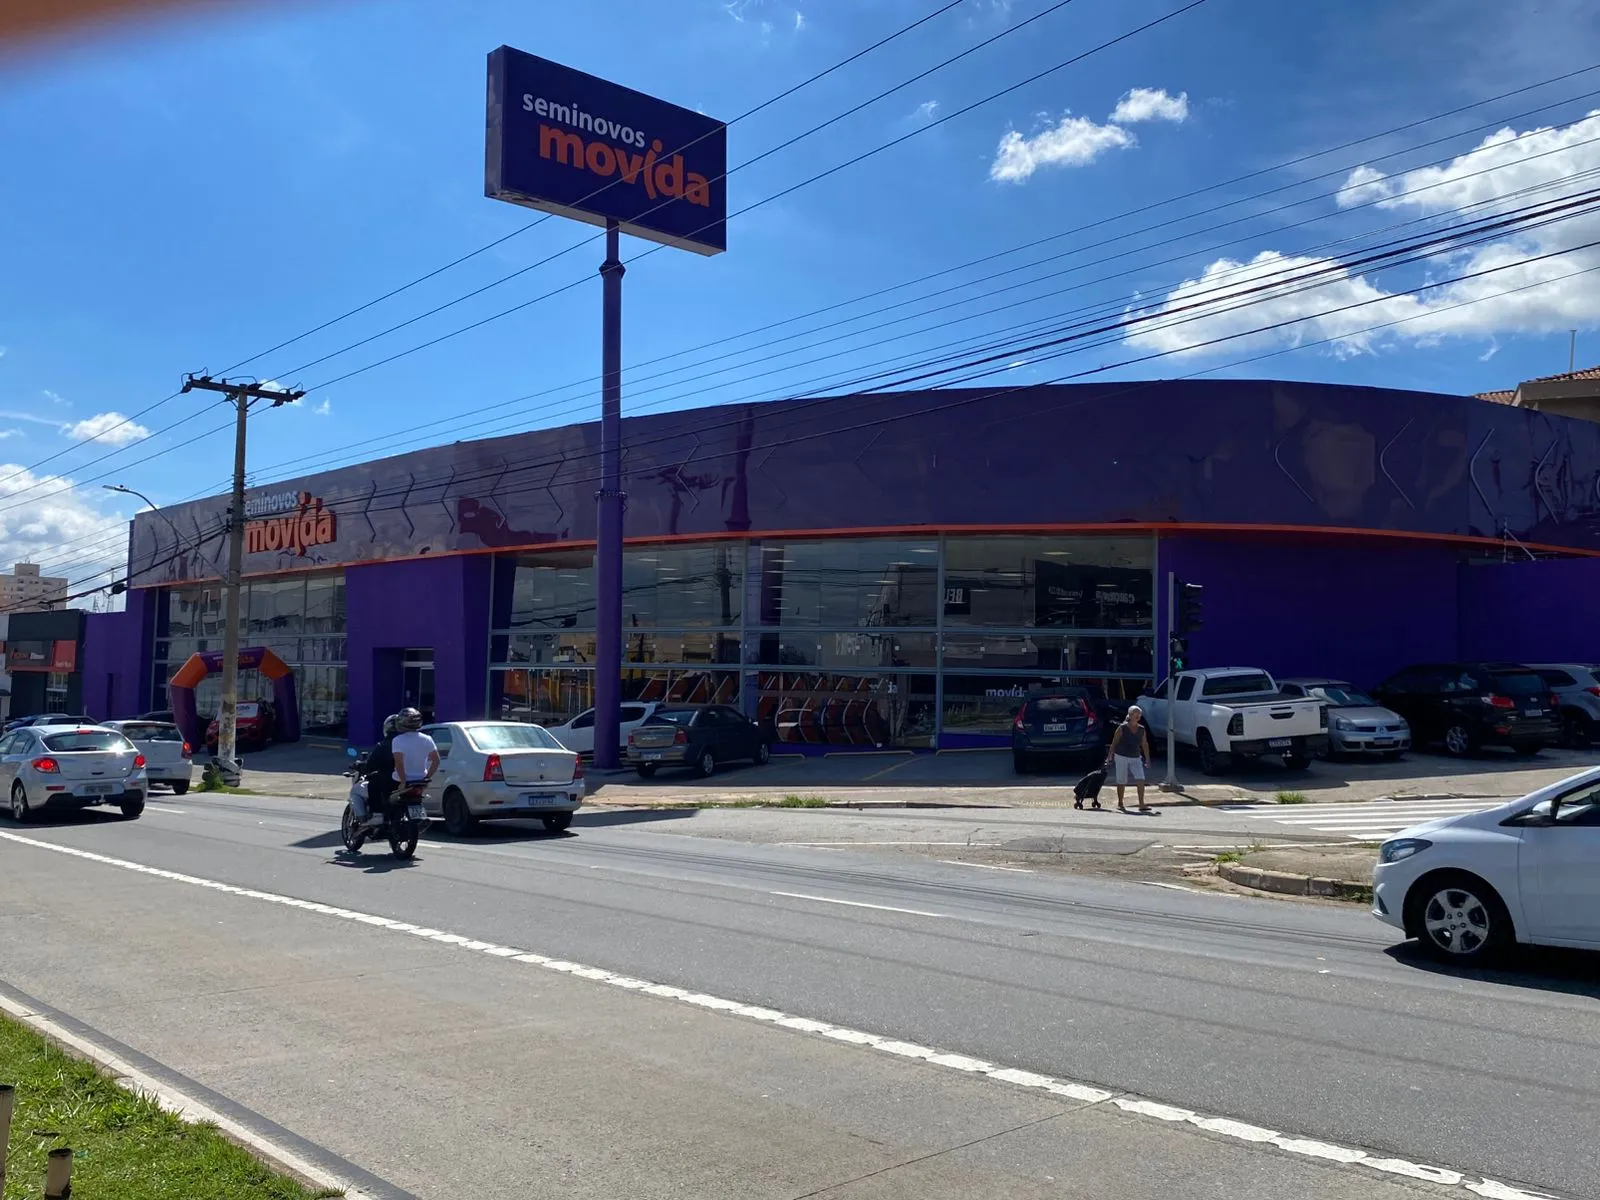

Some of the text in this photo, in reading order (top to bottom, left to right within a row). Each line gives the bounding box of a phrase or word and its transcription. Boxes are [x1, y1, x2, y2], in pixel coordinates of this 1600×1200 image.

[522, 93, 646, 148] seminovos
[539, 123, 710, 208] movida
[244, 491, 298, 517] eminovos
[244, 491, 337, 556] movida
